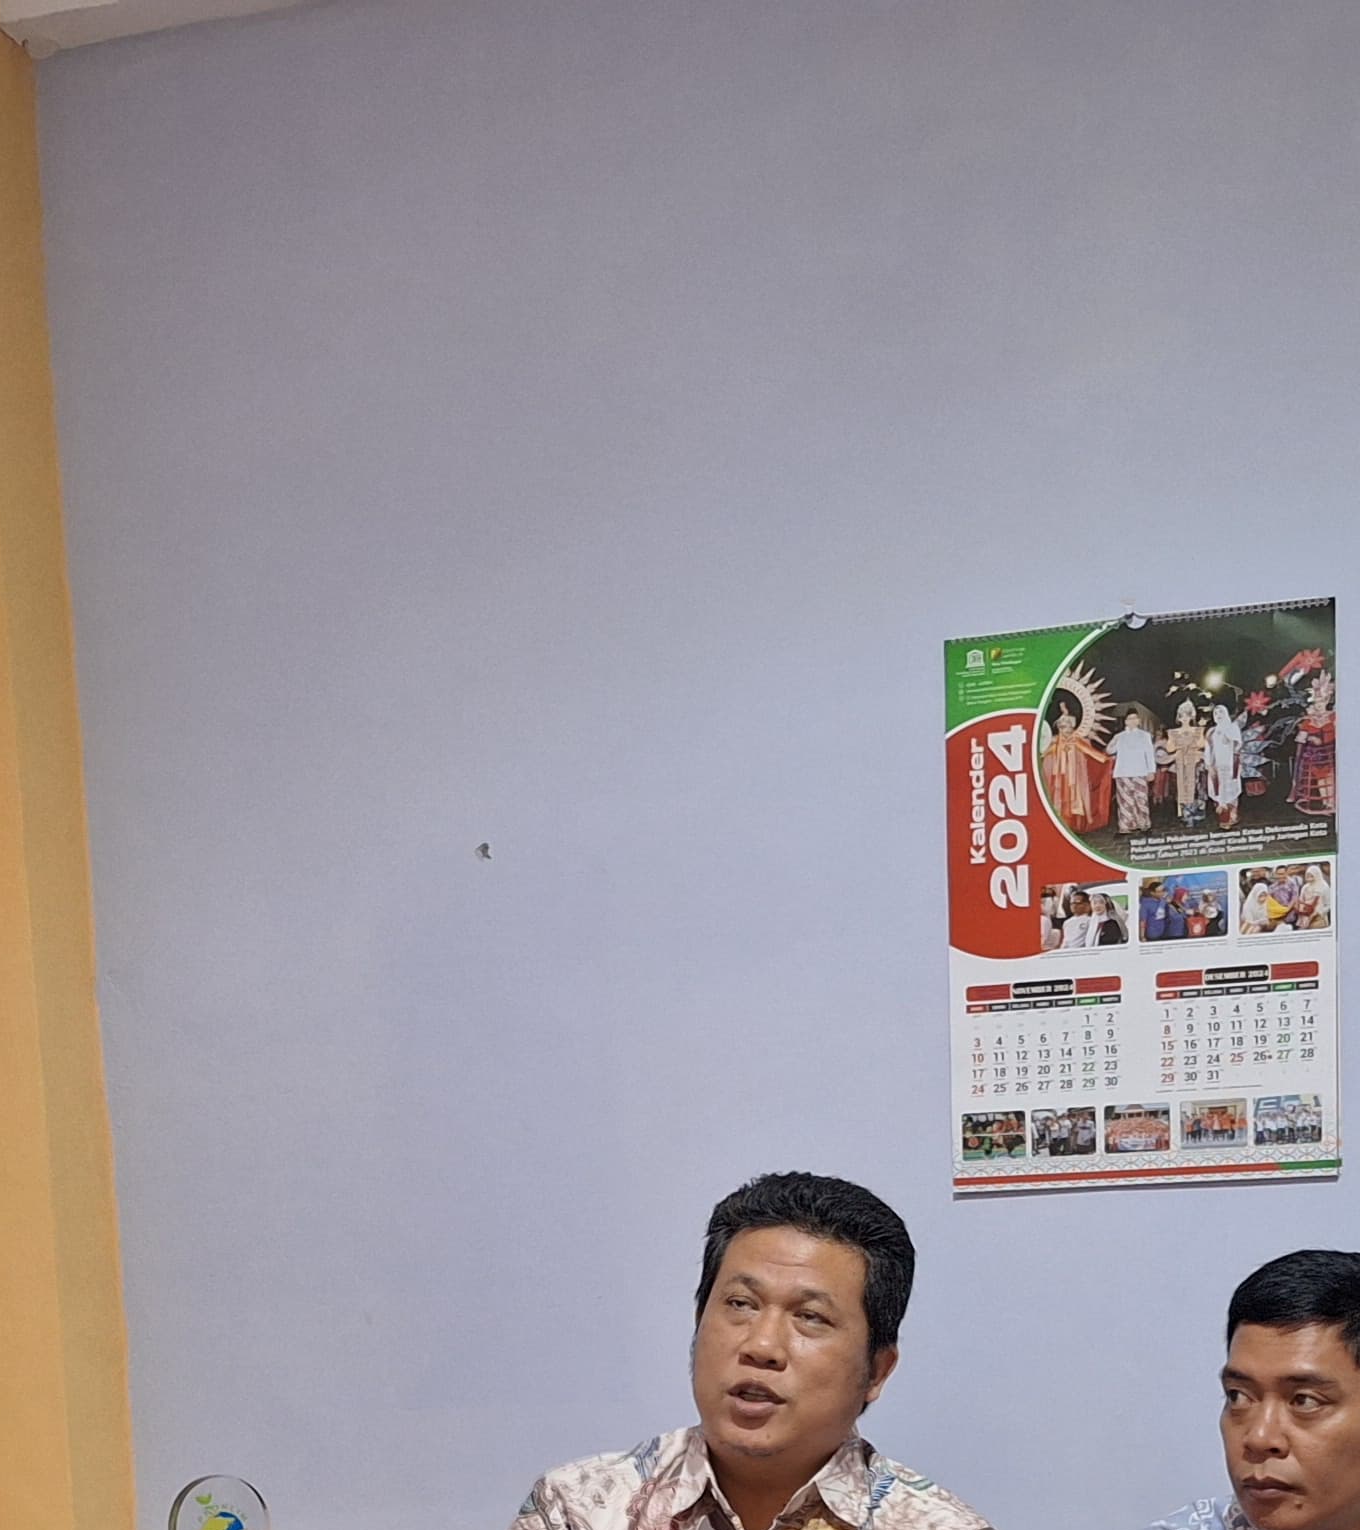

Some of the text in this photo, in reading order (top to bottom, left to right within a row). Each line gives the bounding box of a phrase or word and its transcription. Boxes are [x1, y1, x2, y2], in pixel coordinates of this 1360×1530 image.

[969, 738, 987, 864] Kalender
[987, 725, 1031, 909] 2024
[1166, 833, 1209, 843] Pekalongan
[1165, 999, 1311, 1018] 1 2 3 4 5 6 7
[1085, 1013, 1114, 1024] 1 2
[1164, 1016, 1314, 1034] 8 9 10 11 12 13 14
[974, 1029, 1114, 1048] 3 4 5 6 7 8 9
[1162, 1032, 1313, 1050] 15 16 17 18 19 20 21
[972, 1045, 1117, 1063] 10 11 12 13 14 15 16
[1161, 1048, 1314, 1067] 22 23 24 25 26 27 28
[972, 1061, 1117, 1079] 17 18 19 20 21 22 23
[1161, 1070, 1219, 1083] 29 30 31
[972, 1077, 1118, 1095] 24 25 26 27 28 29 30
